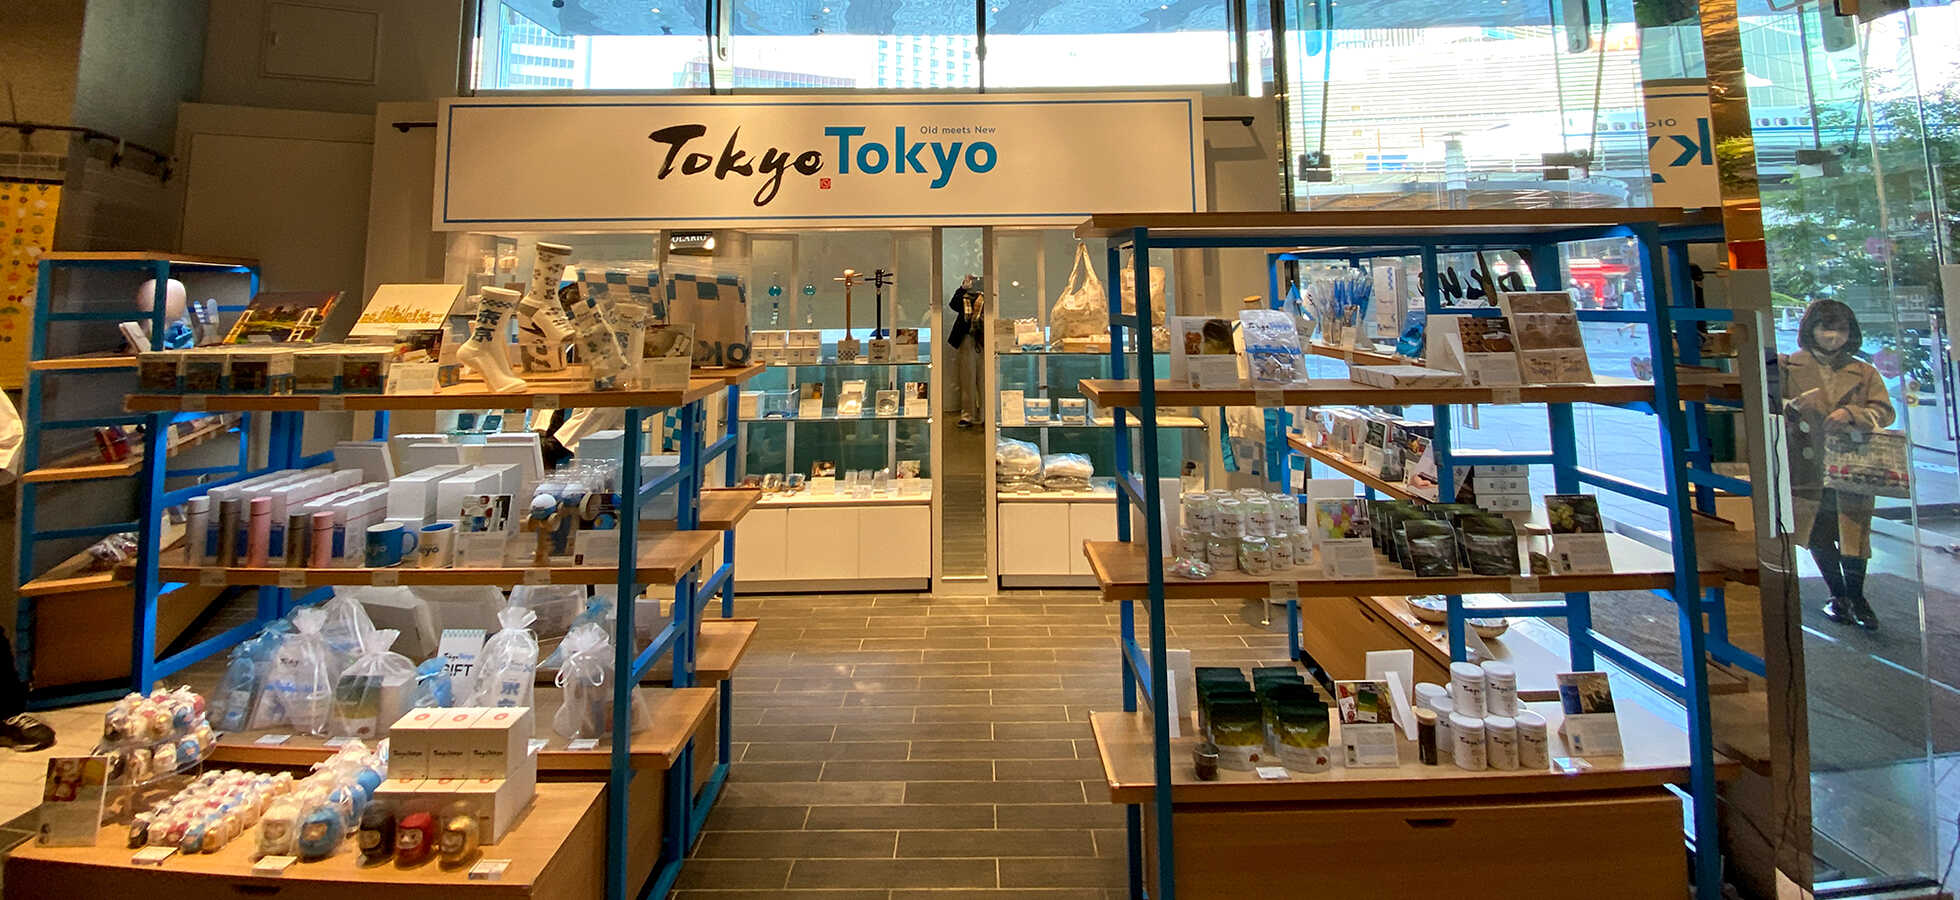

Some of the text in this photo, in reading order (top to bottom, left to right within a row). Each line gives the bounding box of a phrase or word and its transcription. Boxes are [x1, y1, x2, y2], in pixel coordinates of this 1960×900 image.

[920, 126, 996, 134] Old meets New
[648, 124, 998, 207] Tokyo Tokyo
